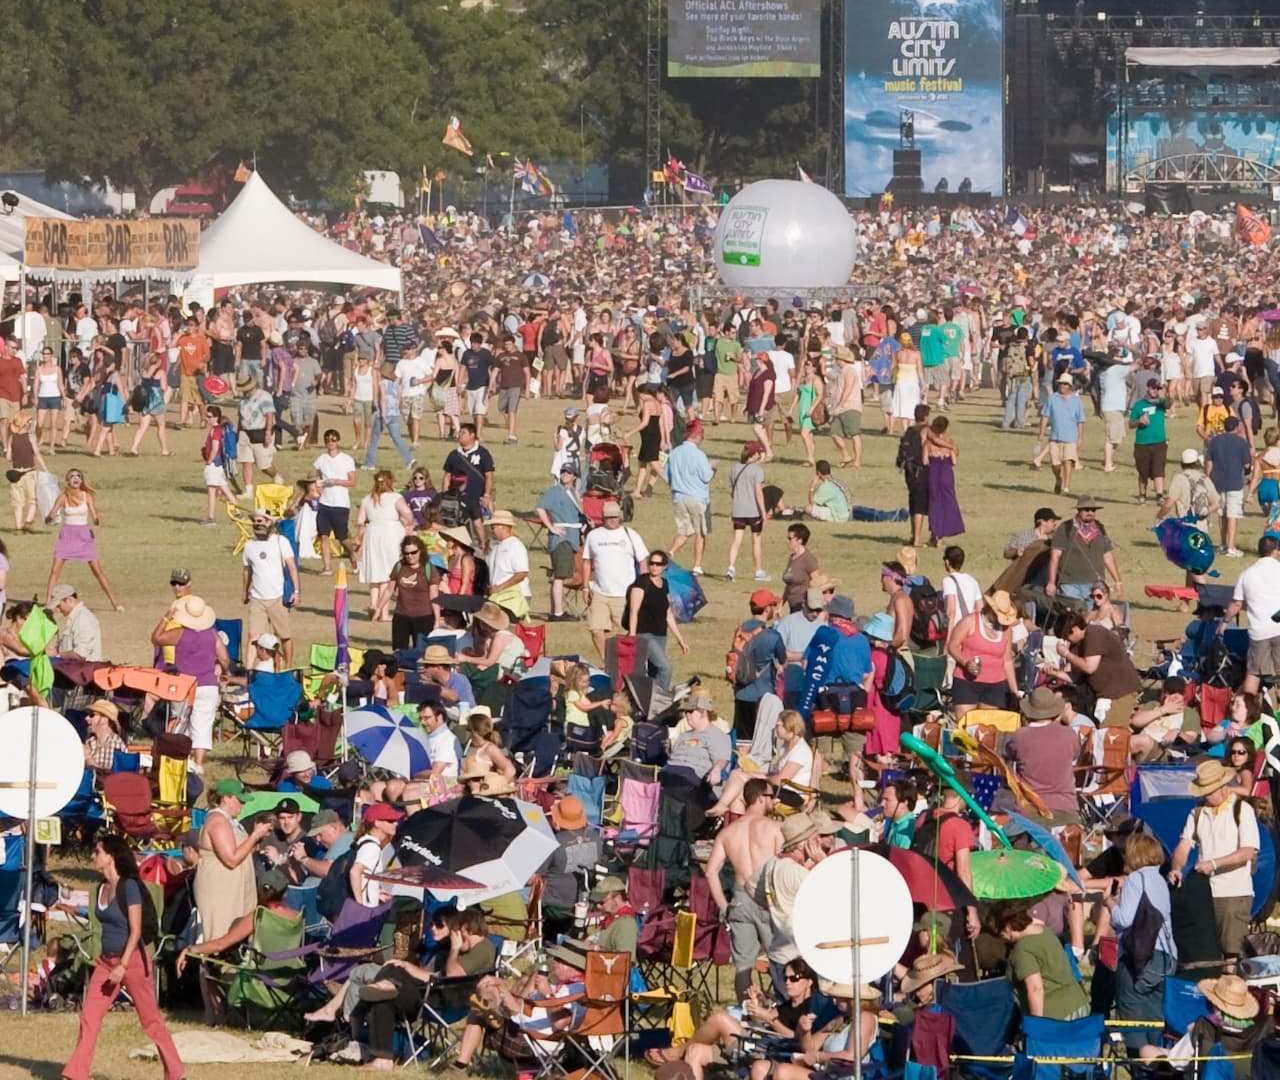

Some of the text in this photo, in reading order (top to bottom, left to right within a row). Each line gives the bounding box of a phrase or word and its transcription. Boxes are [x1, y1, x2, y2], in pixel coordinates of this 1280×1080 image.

[685, 0, 789, 11] Official ACL Aftershows
[685, 12, 699, 21] See
[887, 20, 960, 40] AUSTIN
[900, 39, 946, 57] CITY
[892, 57, 957, 77] LIMITS
[884, 76, 963, 92] music festival
[42, 221, 69, 265] BAR
[105, 223, 132, 265] BAR
[162, 222, 189, 264] BAR
